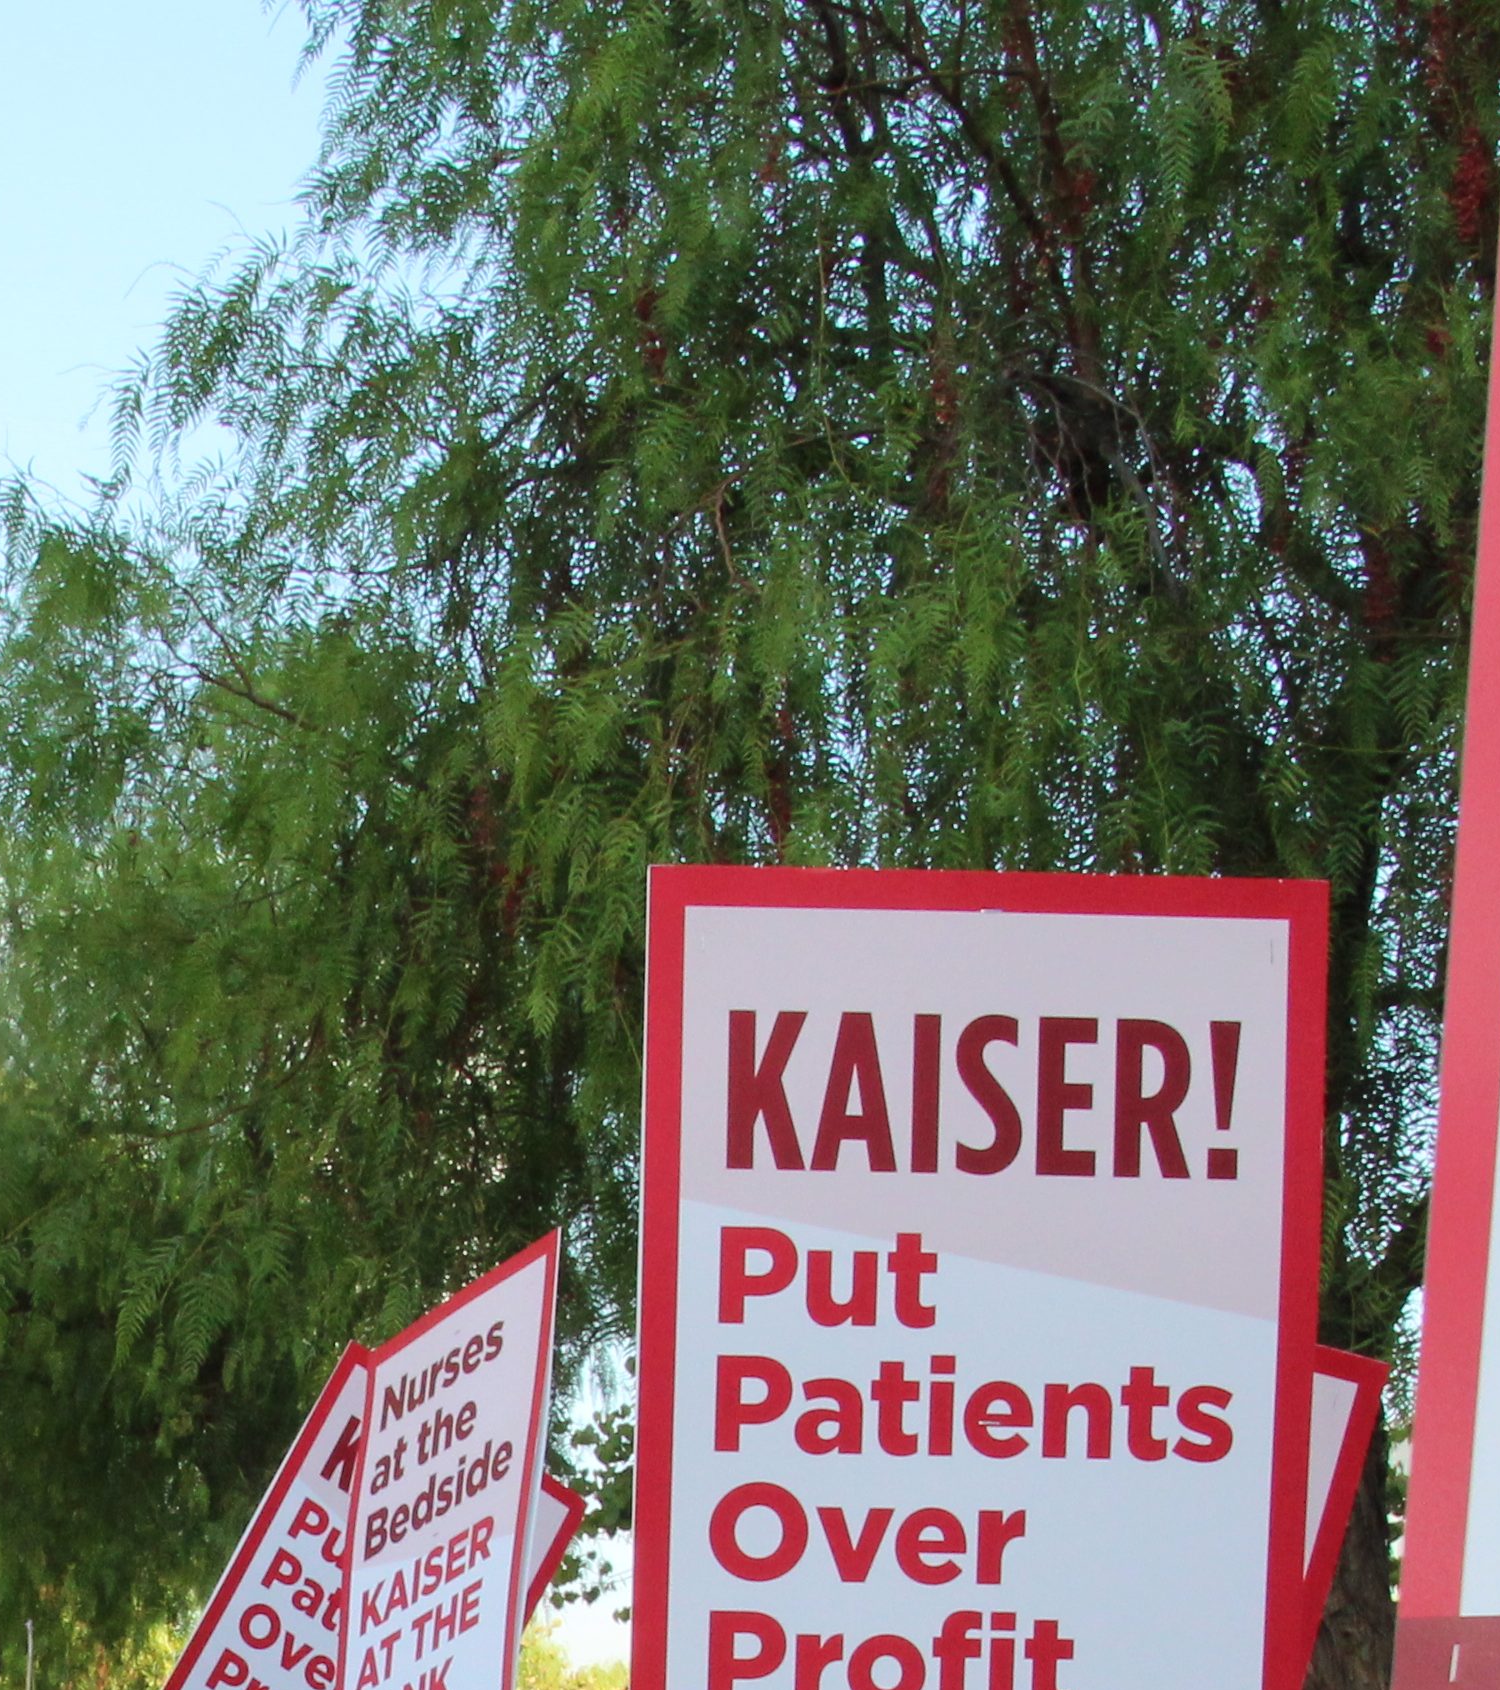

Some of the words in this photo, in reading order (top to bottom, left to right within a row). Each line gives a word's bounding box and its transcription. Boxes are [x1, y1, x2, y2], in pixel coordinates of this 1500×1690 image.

[725, 1009, 1242, 1181] KAISER!
[717, 1226, 939, 1329] Put
[379, 1319, 505, 1433] Nurses
[713, 1354, 1234, 1465] Patients
[363, 1438, 513, 1562] Bedside
[370, 1441, 405, 1495] at
[416, 1399, 478, 1463] the
[287, 1496, 346, 1570] Pu
[359, 1515, 495, 1637] KAISER
[708, 1481, 1027, 1586] Over
[411, 1580, 483, 1652] THE
